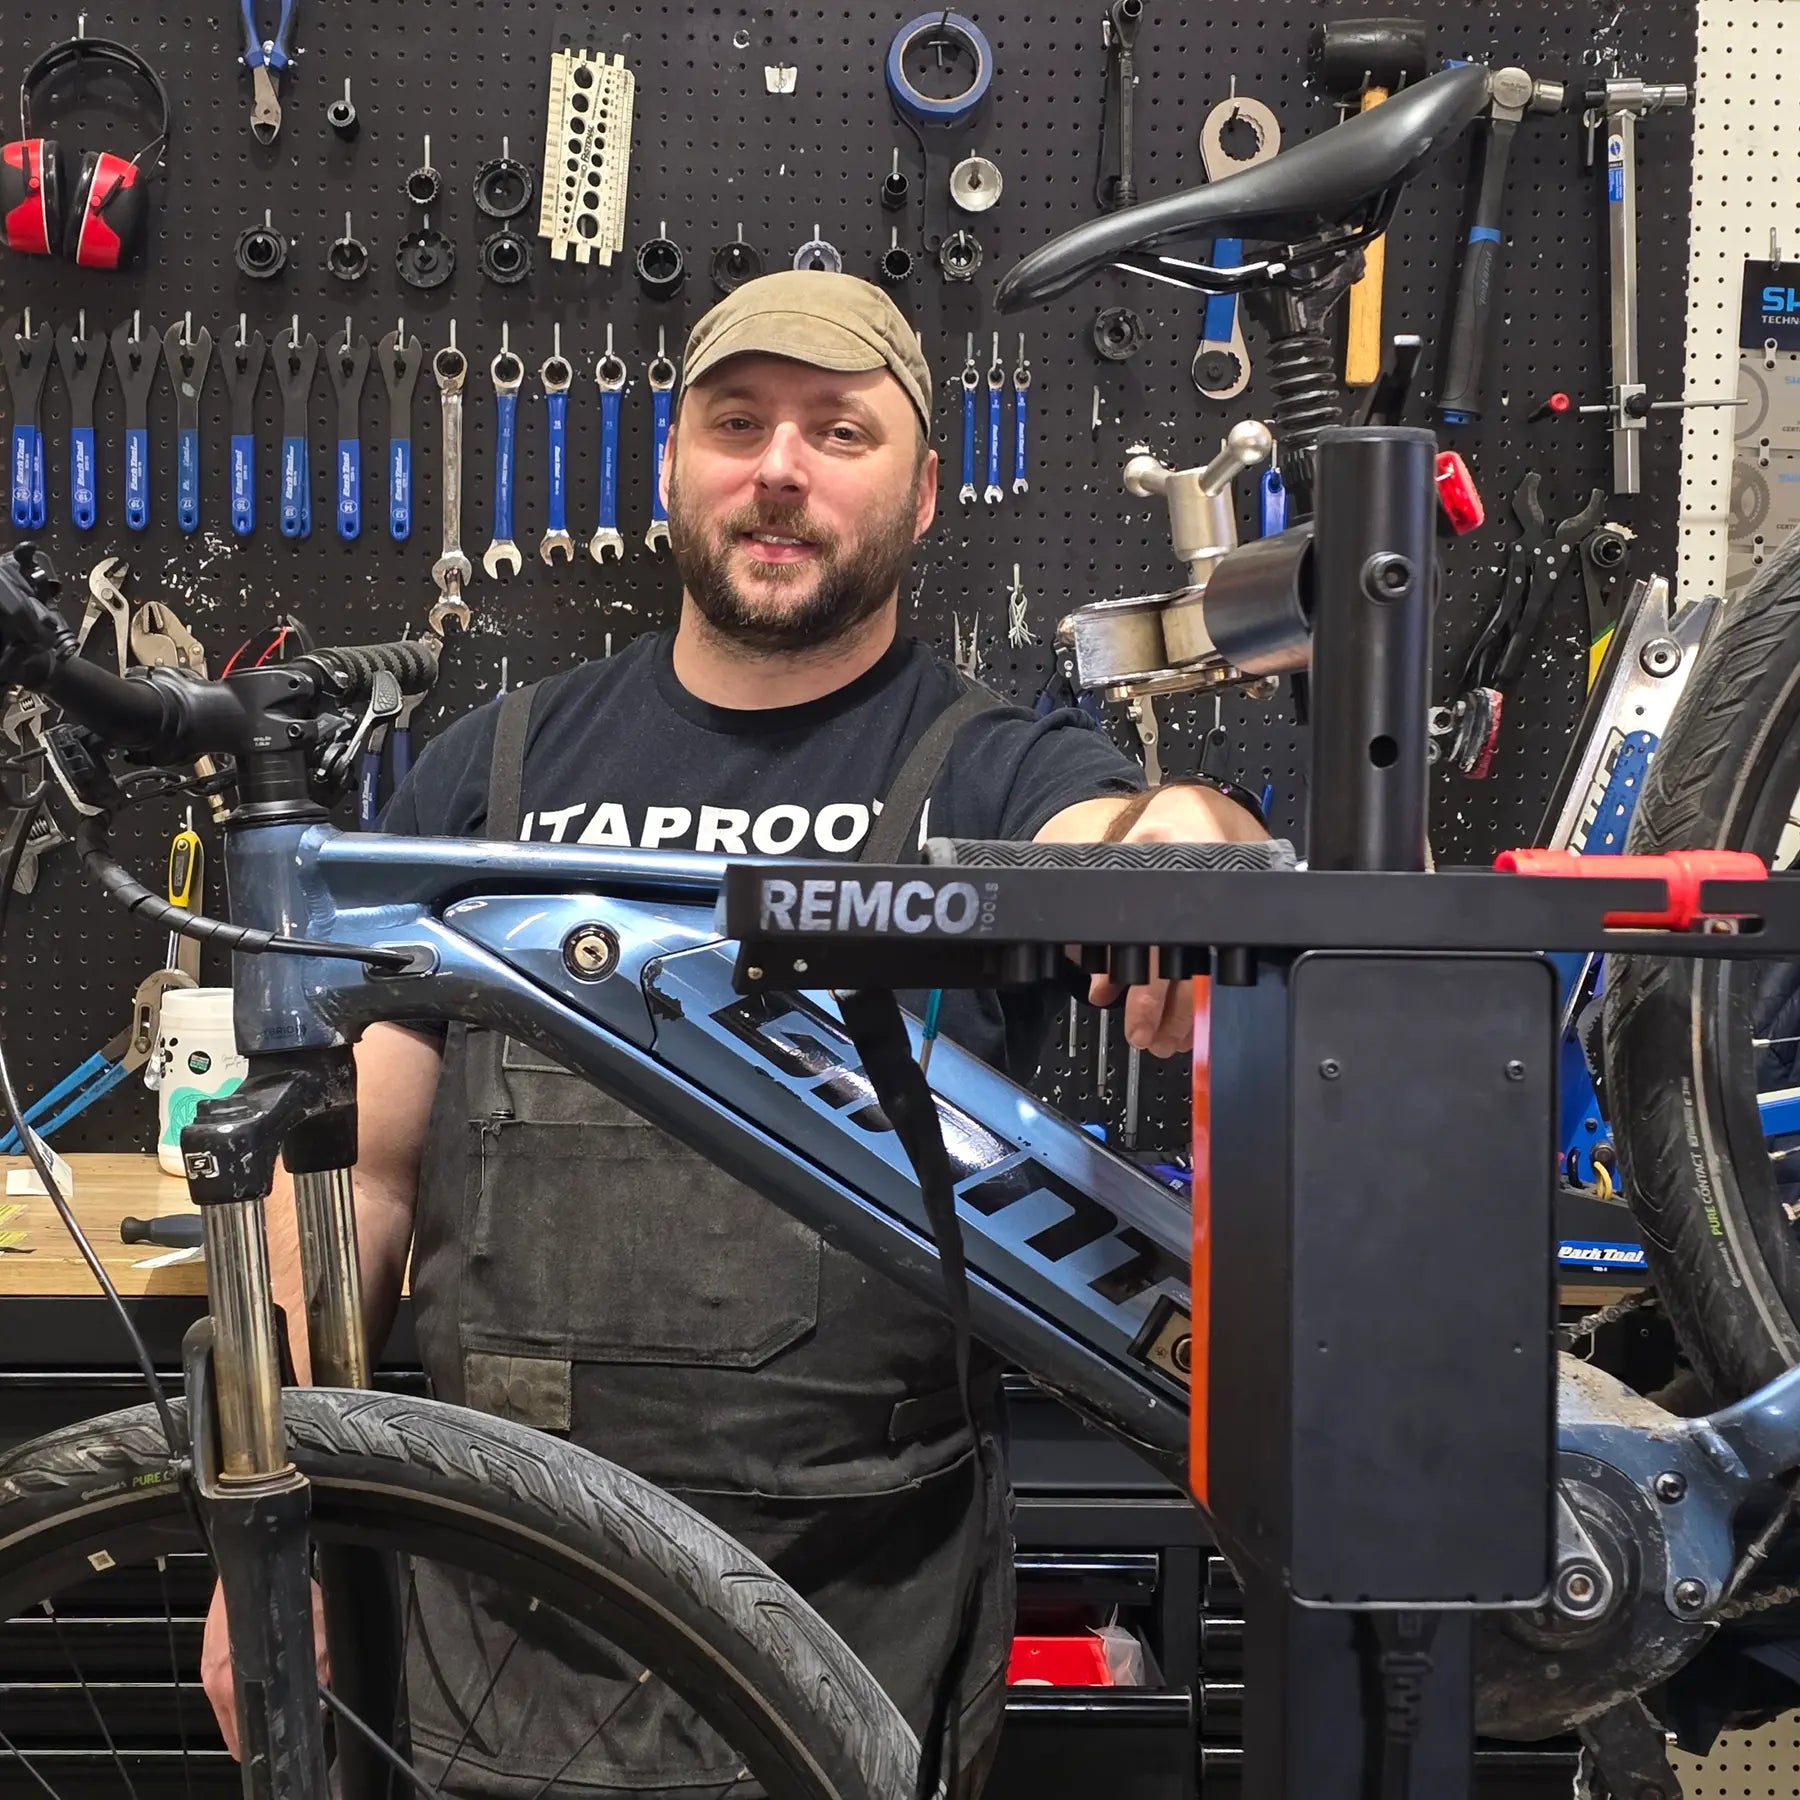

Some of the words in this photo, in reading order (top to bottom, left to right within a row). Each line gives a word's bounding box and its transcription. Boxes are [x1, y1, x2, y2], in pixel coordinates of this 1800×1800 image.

[760, 879, 980, 935] REMCO
[980, 882, 999, 933] TOOLS
[1690, 1151, 1714, 1205] CONTACT
[1704, 1205, 1723, 1236] PURE
[1558, 1246, 1602, 1260] Park
[1601, 1248, 1644, 1263] Tool
[132, 1471, 161, 1488] PURE
